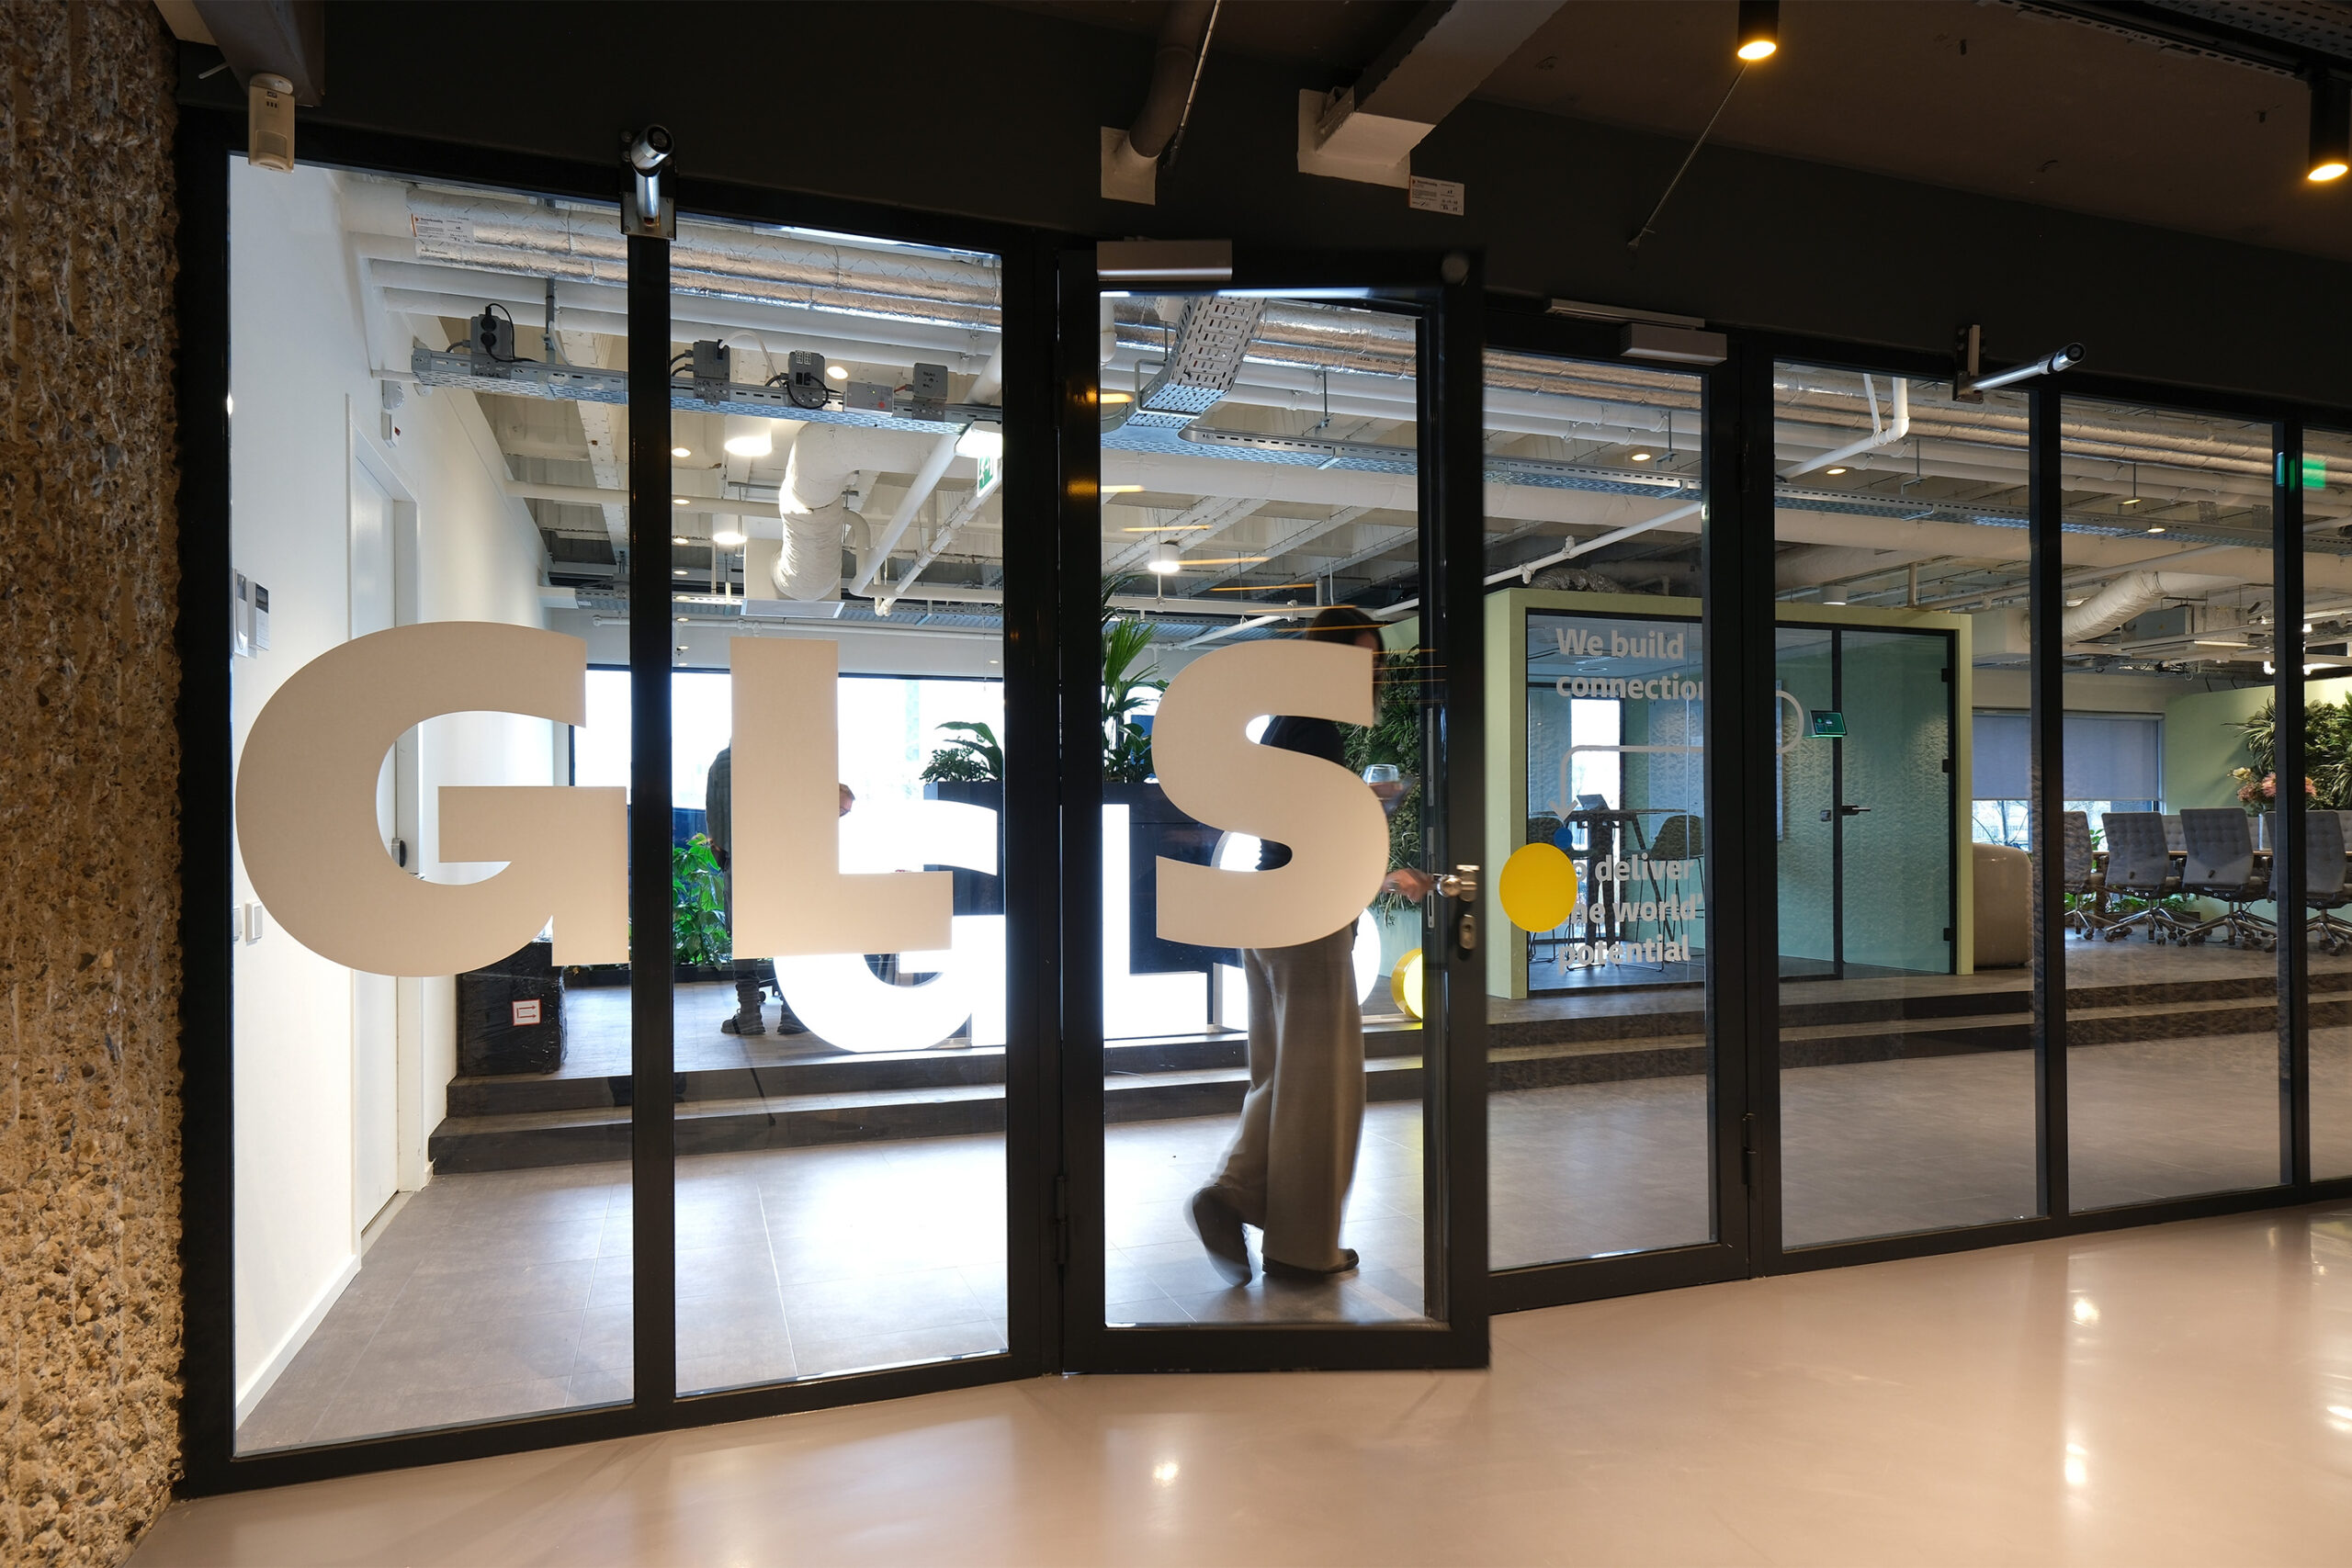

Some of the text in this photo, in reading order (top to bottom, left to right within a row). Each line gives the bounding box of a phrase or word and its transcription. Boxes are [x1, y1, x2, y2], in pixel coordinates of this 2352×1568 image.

[1555, 627, 1684, 660] We build
[236, 622, 1390, 977] GLS
[1572, 852, 1695, 883] o deliver
[1564, 894, 1703, 924] he world'
[1558, 933, 1691, 976] potential
